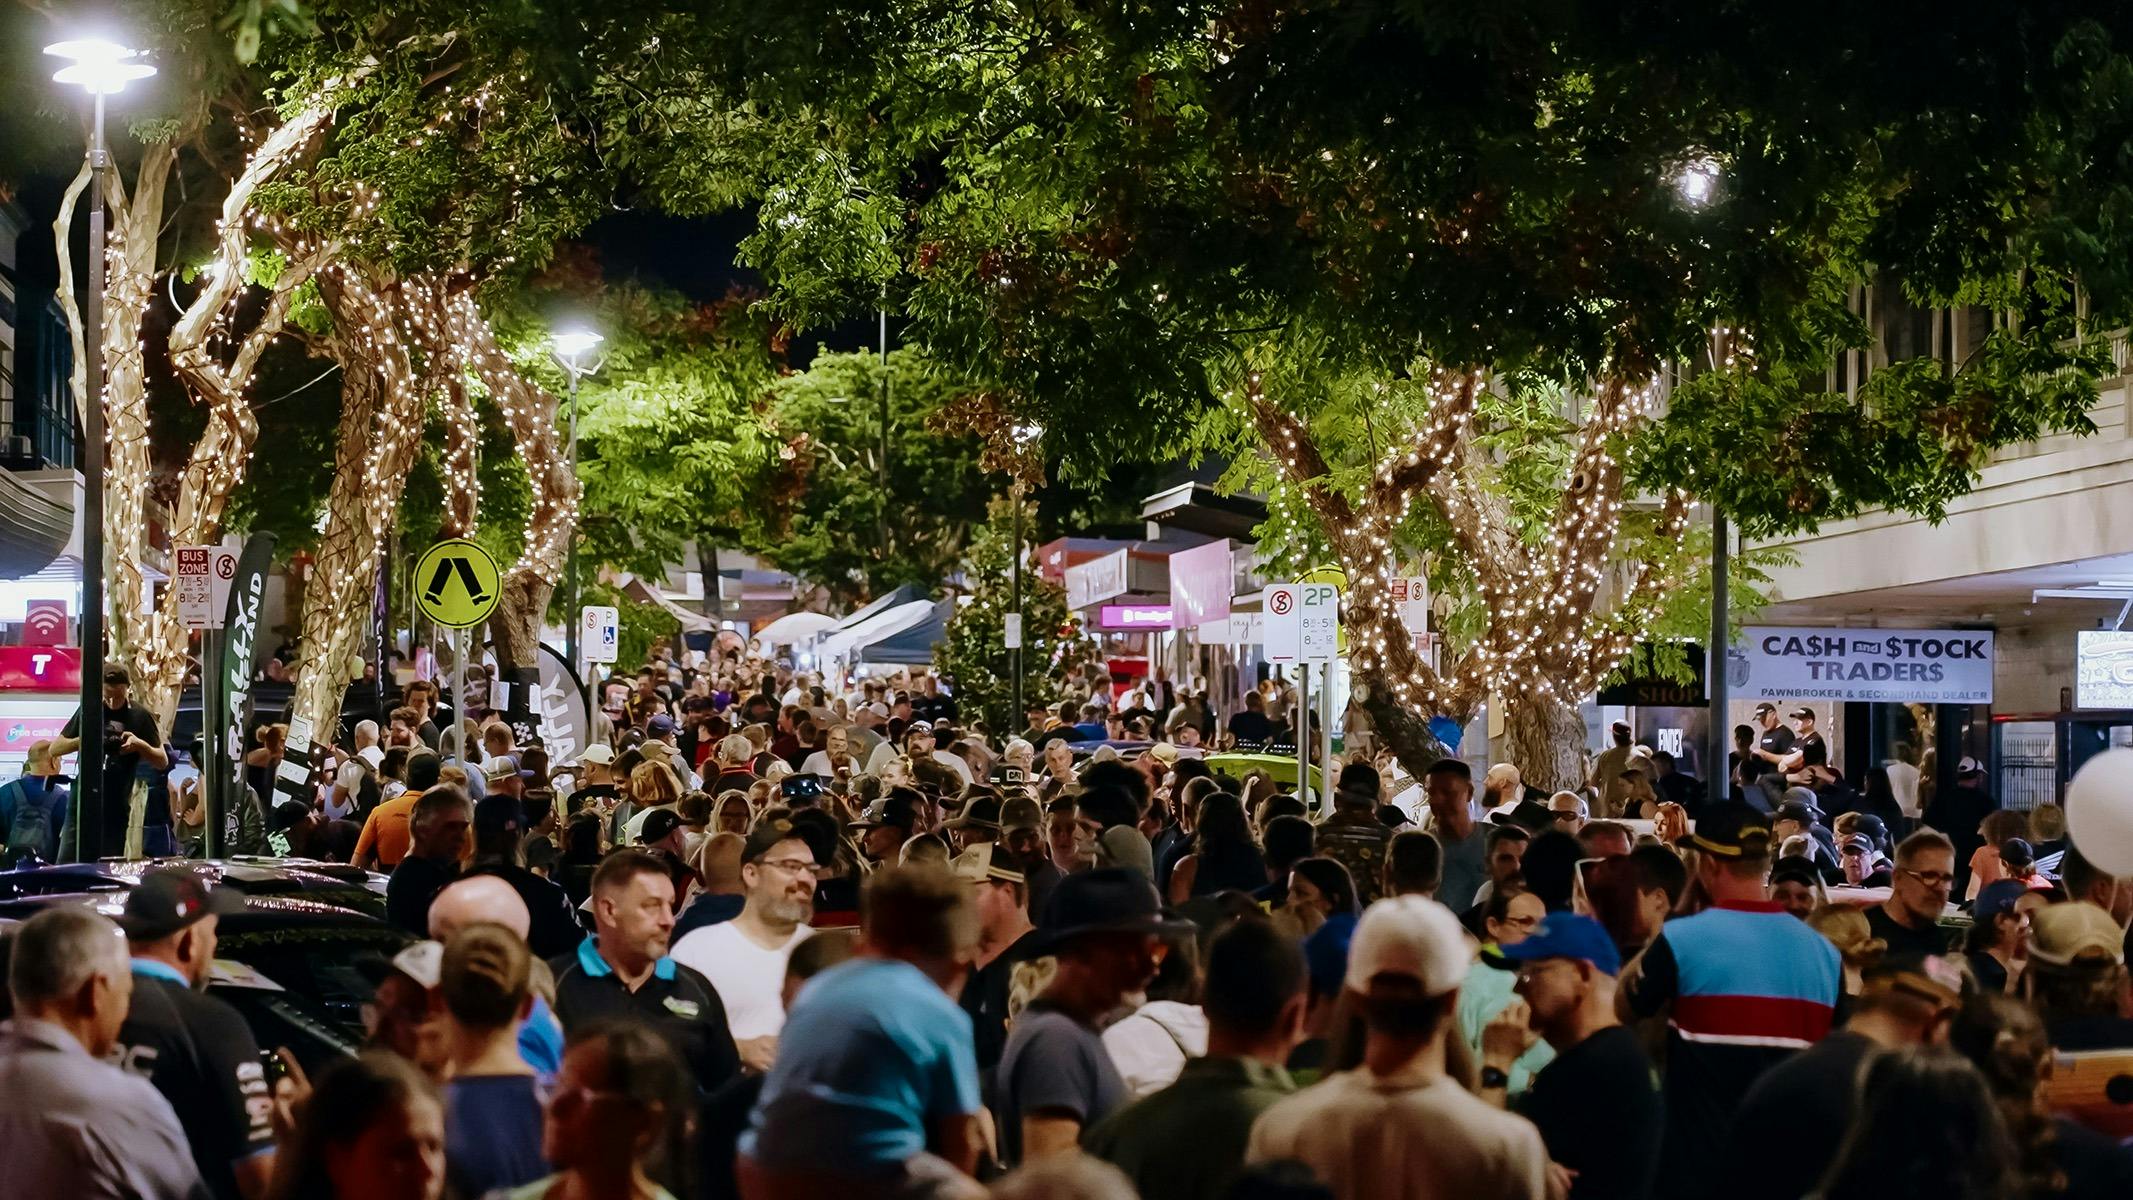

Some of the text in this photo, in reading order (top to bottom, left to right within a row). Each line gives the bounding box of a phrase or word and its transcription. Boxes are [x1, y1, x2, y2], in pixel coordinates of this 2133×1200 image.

[182, 551, 204, 561] BUS
[179, 563, 208, 574] ZONE
[1305, 588, 1333, 605] 2P
[1762, 635, 1987, 659] CA$H and $TOCK
[1806, 661, 1944, 683] TRADER$
[1639, 687, 1699, 703] SHOP
[1761, 688, 1988, 699] PAWNBROKER & SECONDHAND DEALER
[1009, 771, 1022, 780] CAT
